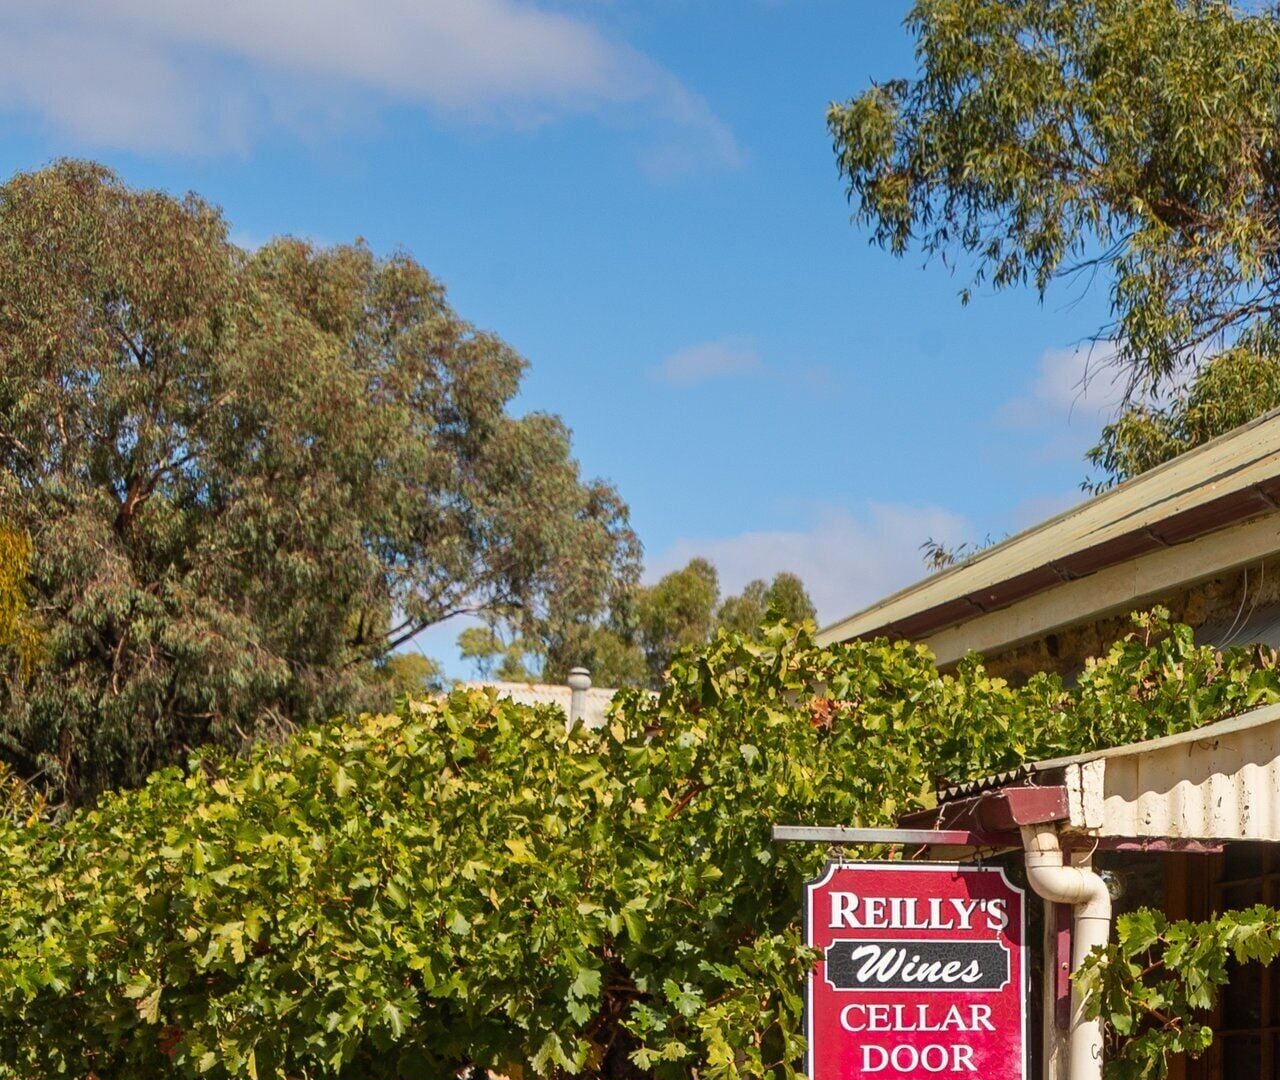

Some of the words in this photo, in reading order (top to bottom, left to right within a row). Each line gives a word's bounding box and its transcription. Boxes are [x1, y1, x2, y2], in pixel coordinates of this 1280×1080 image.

[827, 891, 1009, 930] REILLY'S
[851, 944, 983, 983] Wines
[839, 1003, 996, 1032] CELLAR
[860, 1044, 978, 1073] DOOR
